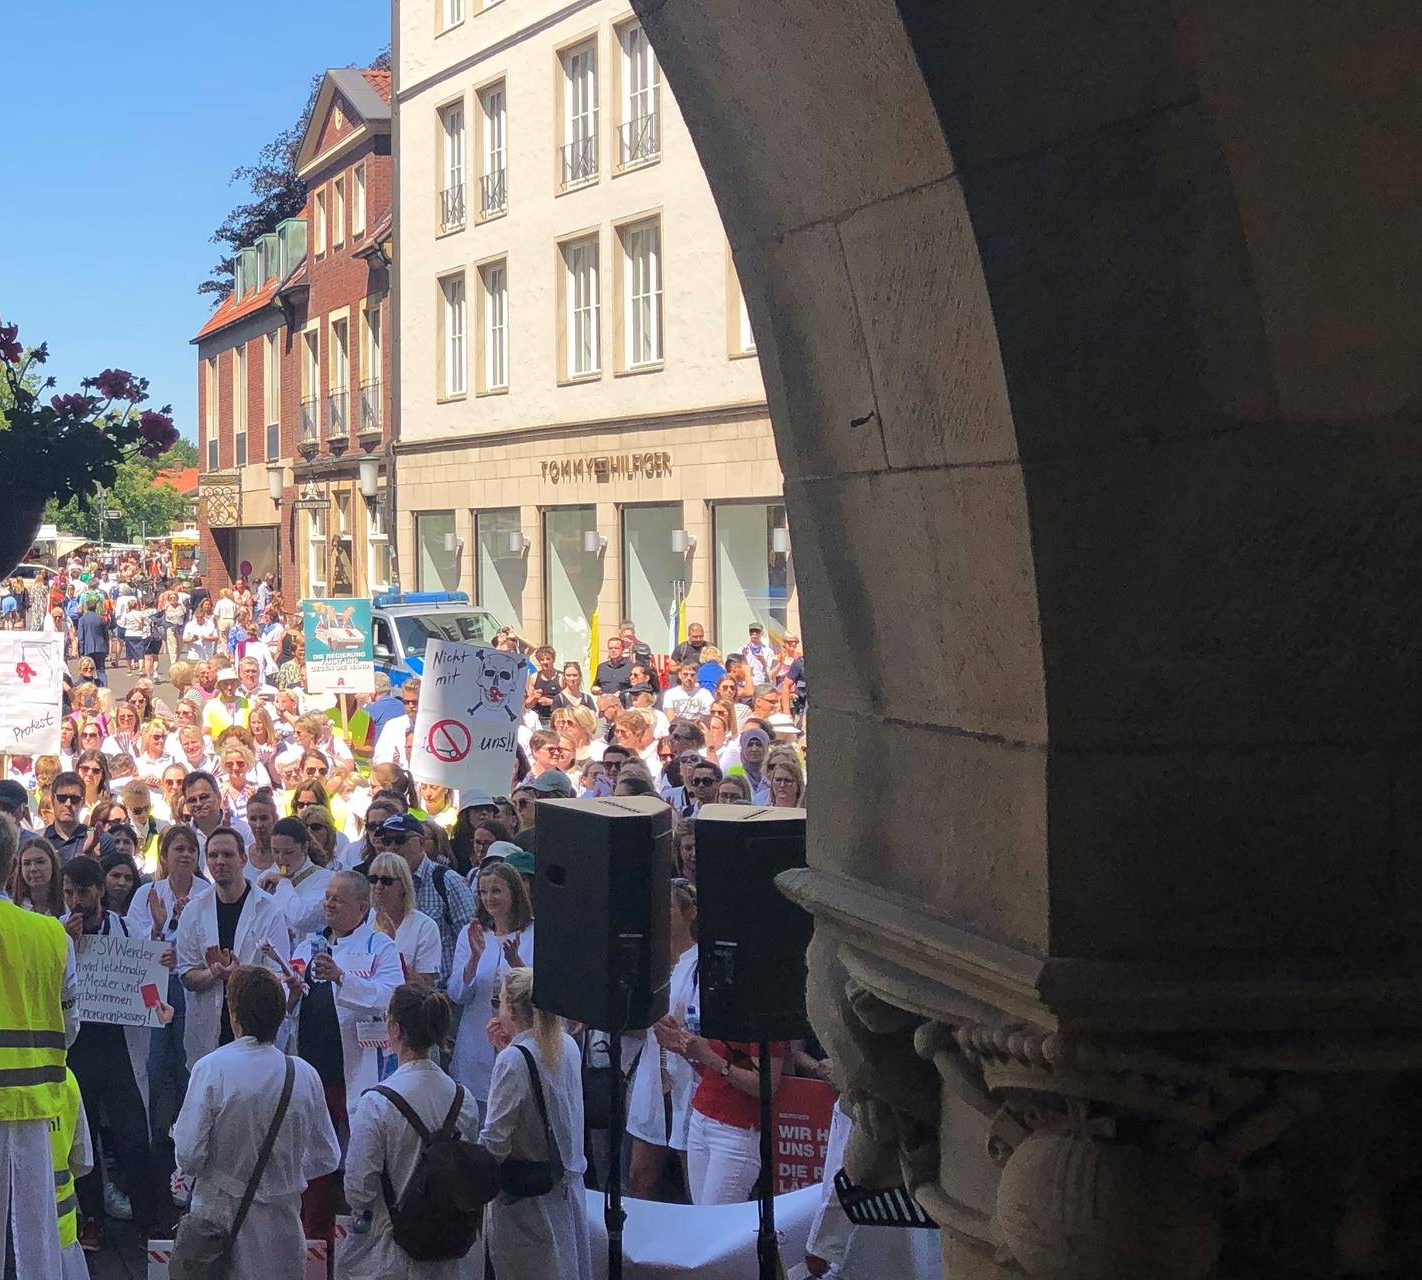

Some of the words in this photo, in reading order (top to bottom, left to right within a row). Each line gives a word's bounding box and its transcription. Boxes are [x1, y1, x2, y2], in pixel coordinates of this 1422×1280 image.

[539, 458, 594, 484] TOMMY
[610, 452, 672, 480] HILFIGER
[433, 649, 470, 669] Nicht
[435, 670, 462, 687] mit
[12, 712, 55, 743] Protest
[481, 732, 515, 752] uns!!
[778, 1125, 812, 1140] WIR
[779, 1142, 815, 1158] UNS
[779, 1163, 808, 1178] DIE
